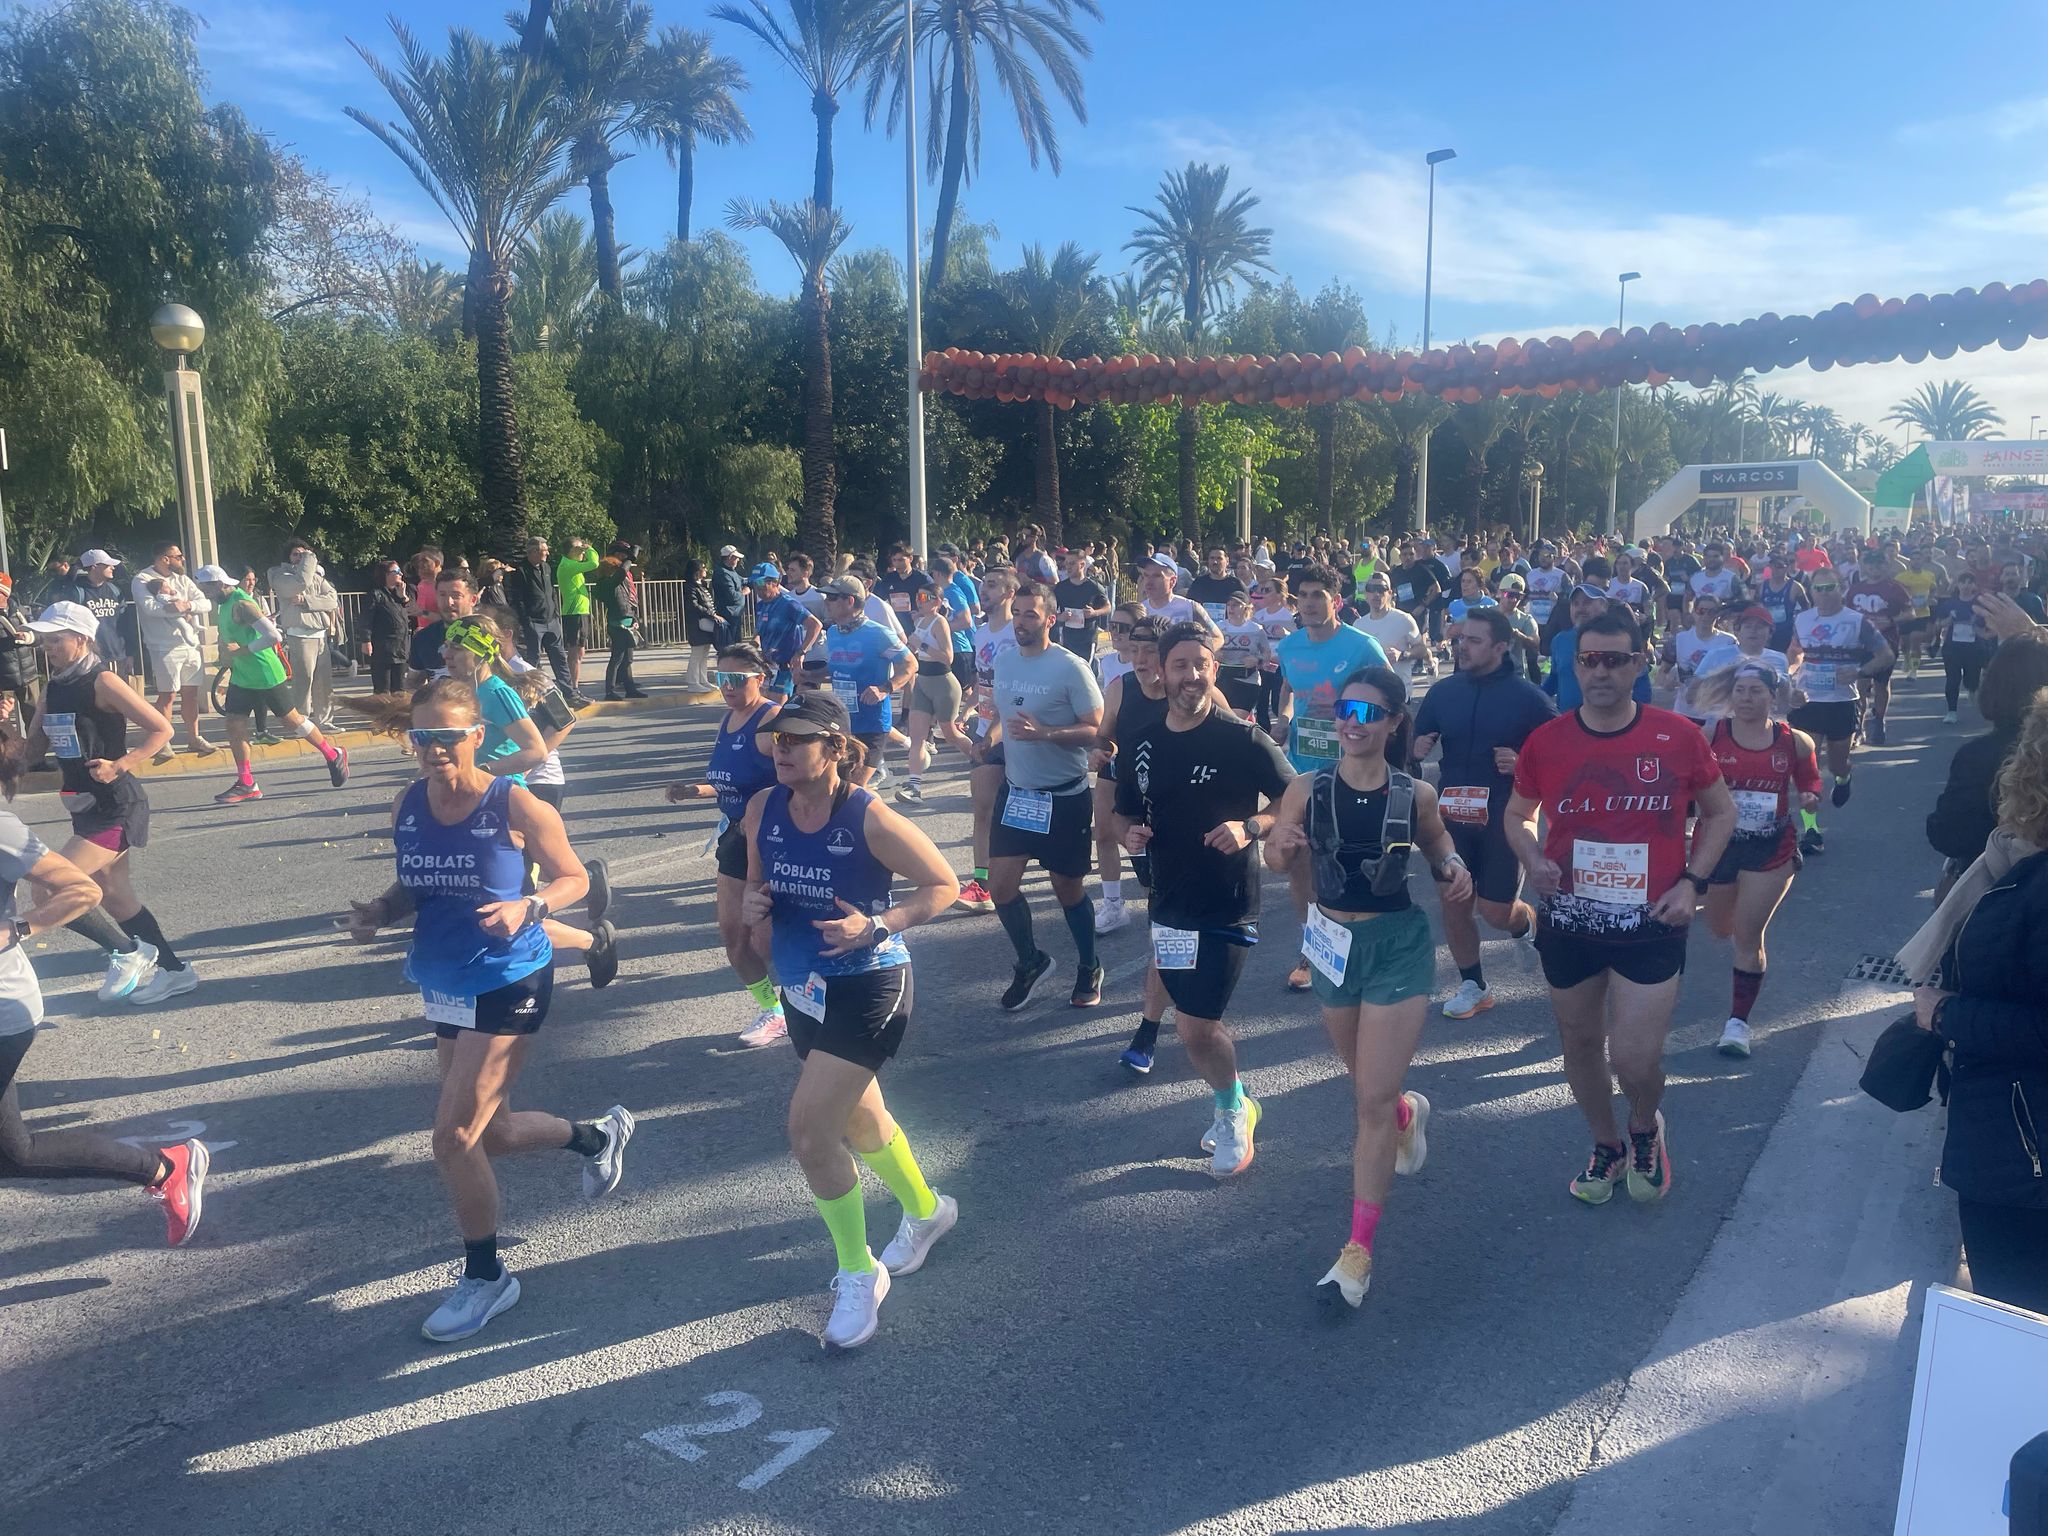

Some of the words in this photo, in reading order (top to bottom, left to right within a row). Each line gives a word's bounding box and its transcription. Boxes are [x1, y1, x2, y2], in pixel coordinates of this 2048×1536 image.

[1712, 470, 1785, 484] MARCOS
[86, 598, 119, 610] BelAir
[94, 608, 115, 617] 1970
[1307, 738, 1329, 750] 418
[1557, 797, 1596, 814] C.A.
[1605, 795, 1673, 811] UTIEL
[1007, 805, 1048, 823] 3223
[401, 853, 477, 869] POBLATS
[1592, 860, 1627, 872] RUBÉN
[399, 870, 482, 888] MARÍTIMS
[773, 861, 832, 882] POBLATS
[1577, 870, 1643, 889] 10427
[769, 879, 834, 899] MARÍTIMS
[1157, 939, 1196, 955] 2699
